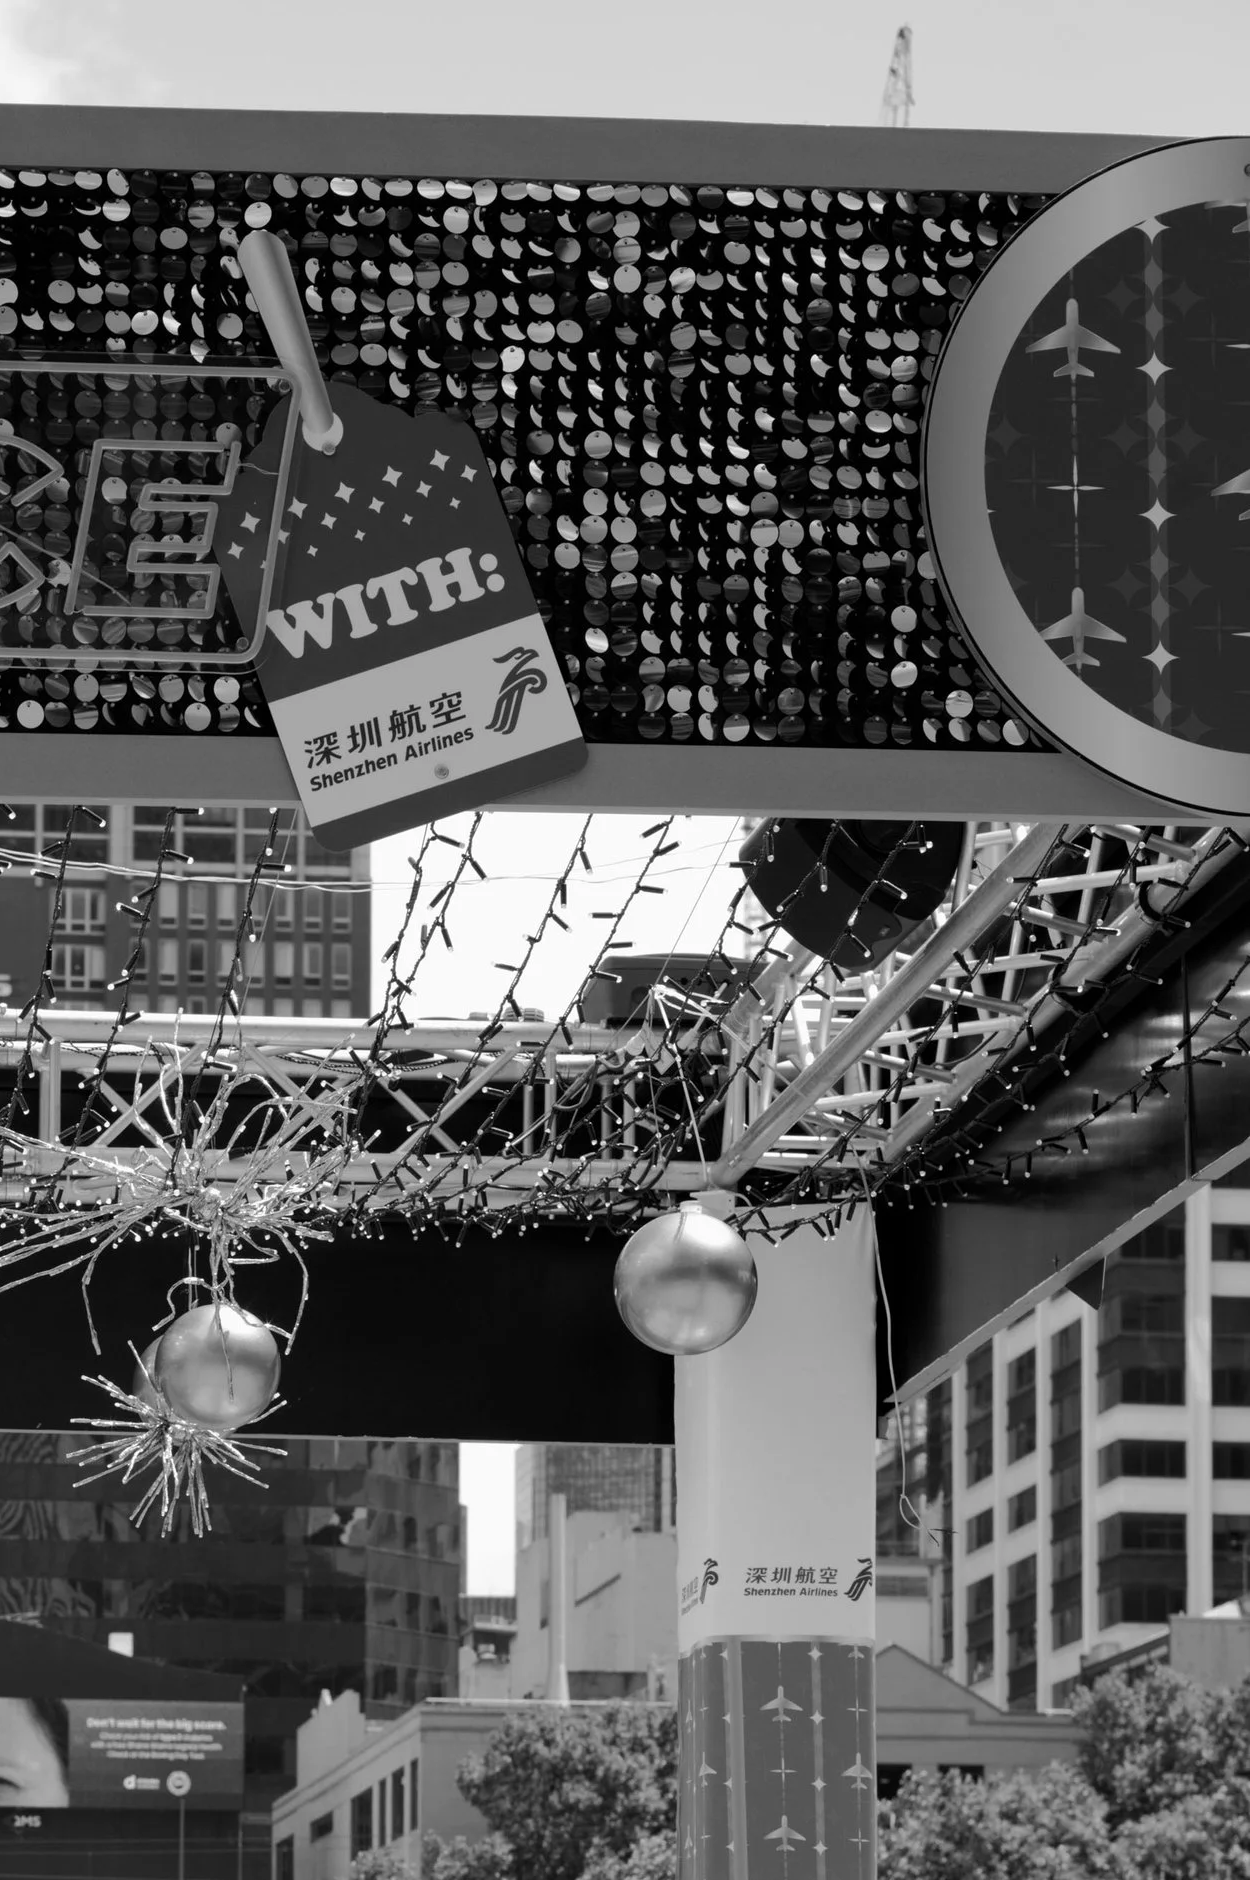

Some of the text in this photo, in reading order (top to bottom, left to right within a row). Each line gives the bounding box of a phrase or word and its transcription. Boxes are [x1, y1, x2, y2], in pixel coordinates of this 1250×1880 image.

[267, 547, 505, 659] WITH:
[304, 691, 467, 769] 深圳航空
[309, 727, 474, 792] Shenzhen Airlines
[743, 1587, 838, 1597] Shenzhen Airlines
[745, 1566, 838, 1585] 深圳航空
